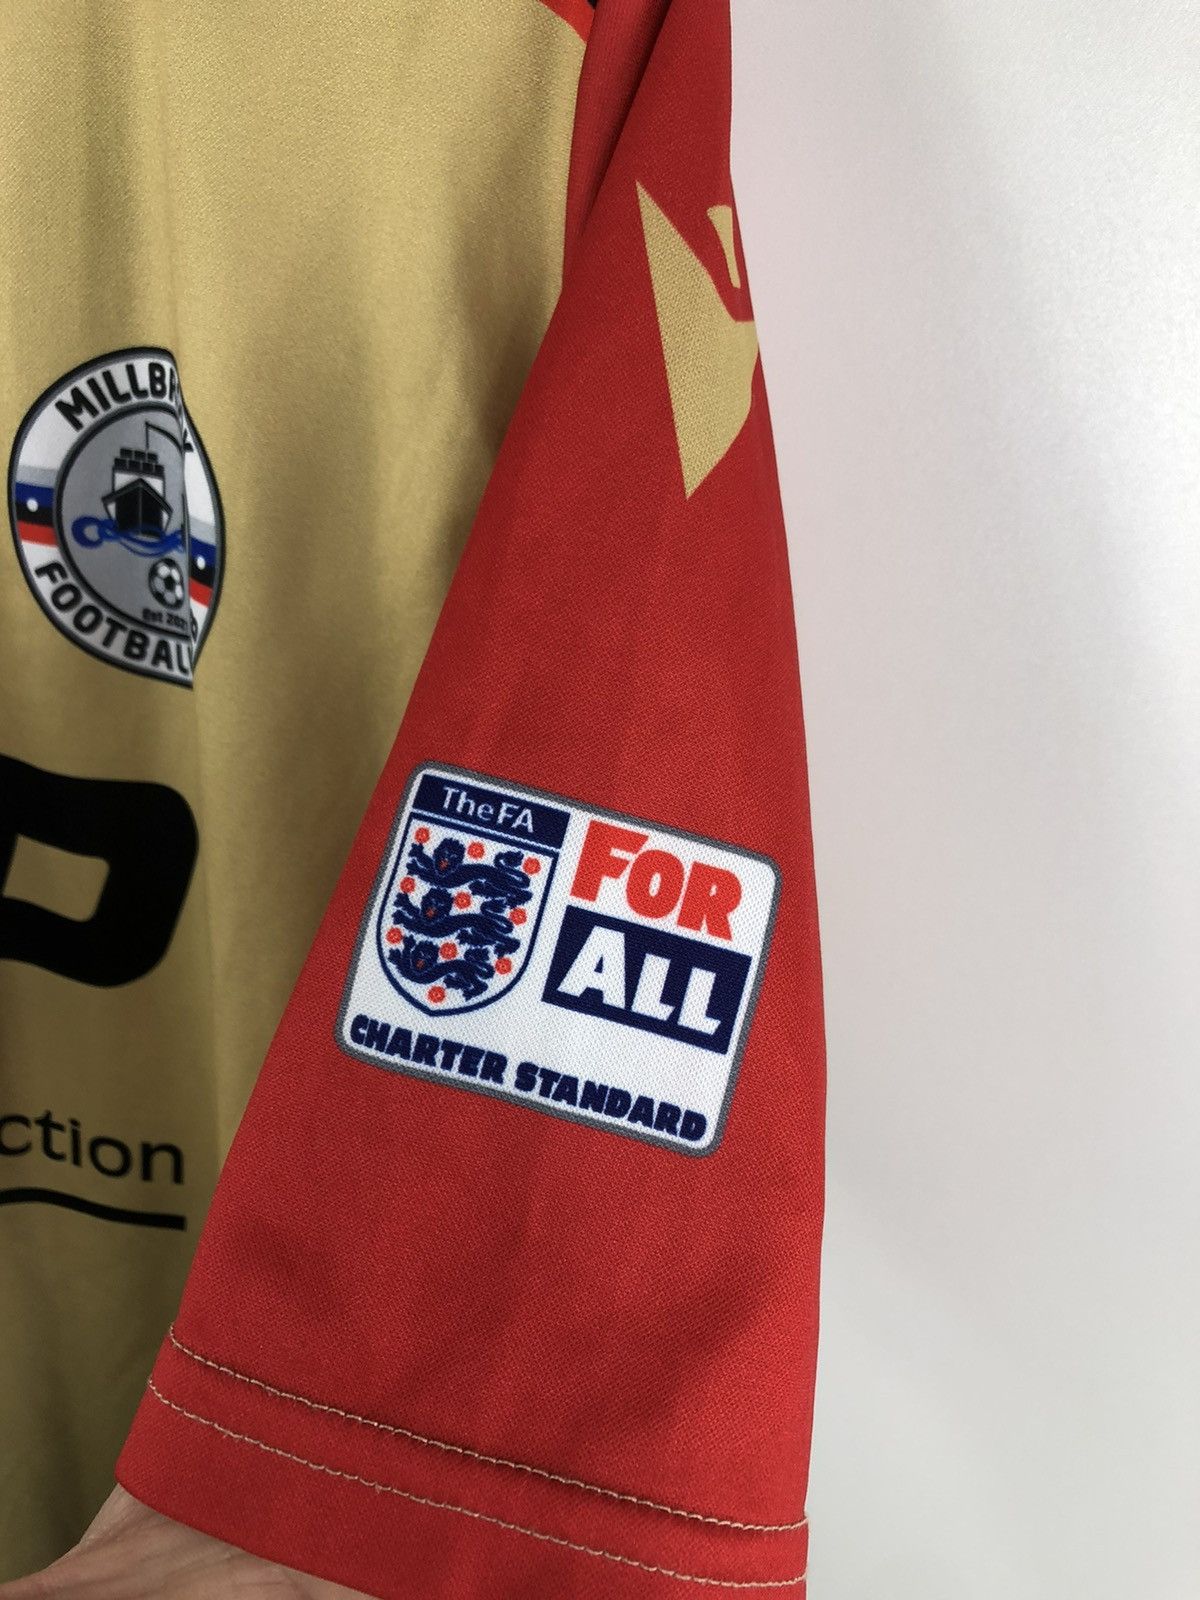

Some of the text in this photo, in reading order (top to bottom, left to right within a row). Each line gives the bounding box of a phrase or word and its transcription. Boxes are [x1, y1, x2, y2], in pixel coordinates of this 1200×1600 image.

[570, 819, 743, 941] FOR
[558, 927, 721, 1036] ALL
[350, 1014, 708, 1143] CHARTER STANDARD
